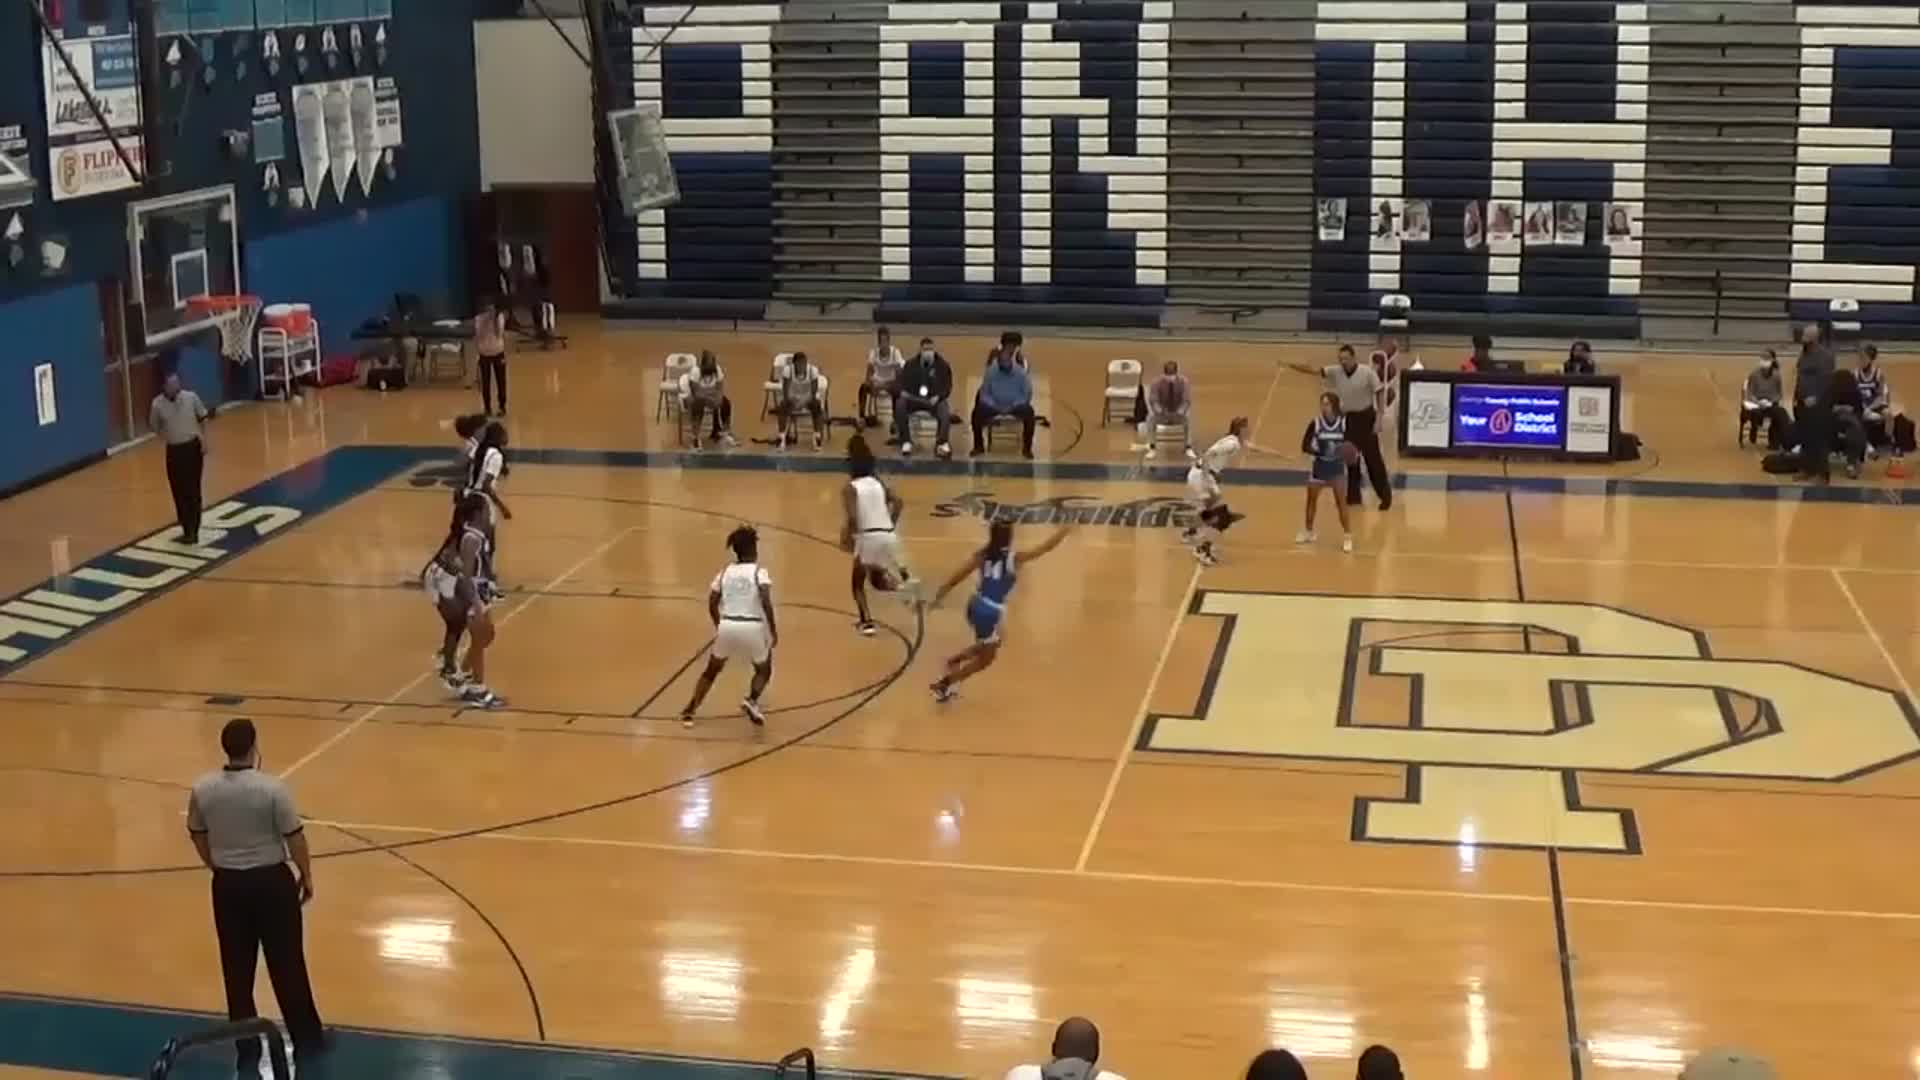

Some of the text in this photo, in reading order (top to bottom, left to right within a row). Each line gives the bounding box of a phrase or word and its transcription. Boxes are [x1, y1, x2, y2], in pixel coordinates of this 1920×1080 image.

[1460, 414, 1488, 425] Your
[1515, 412, 1555, 423] School
[1514, 423, 1557, 434] District
